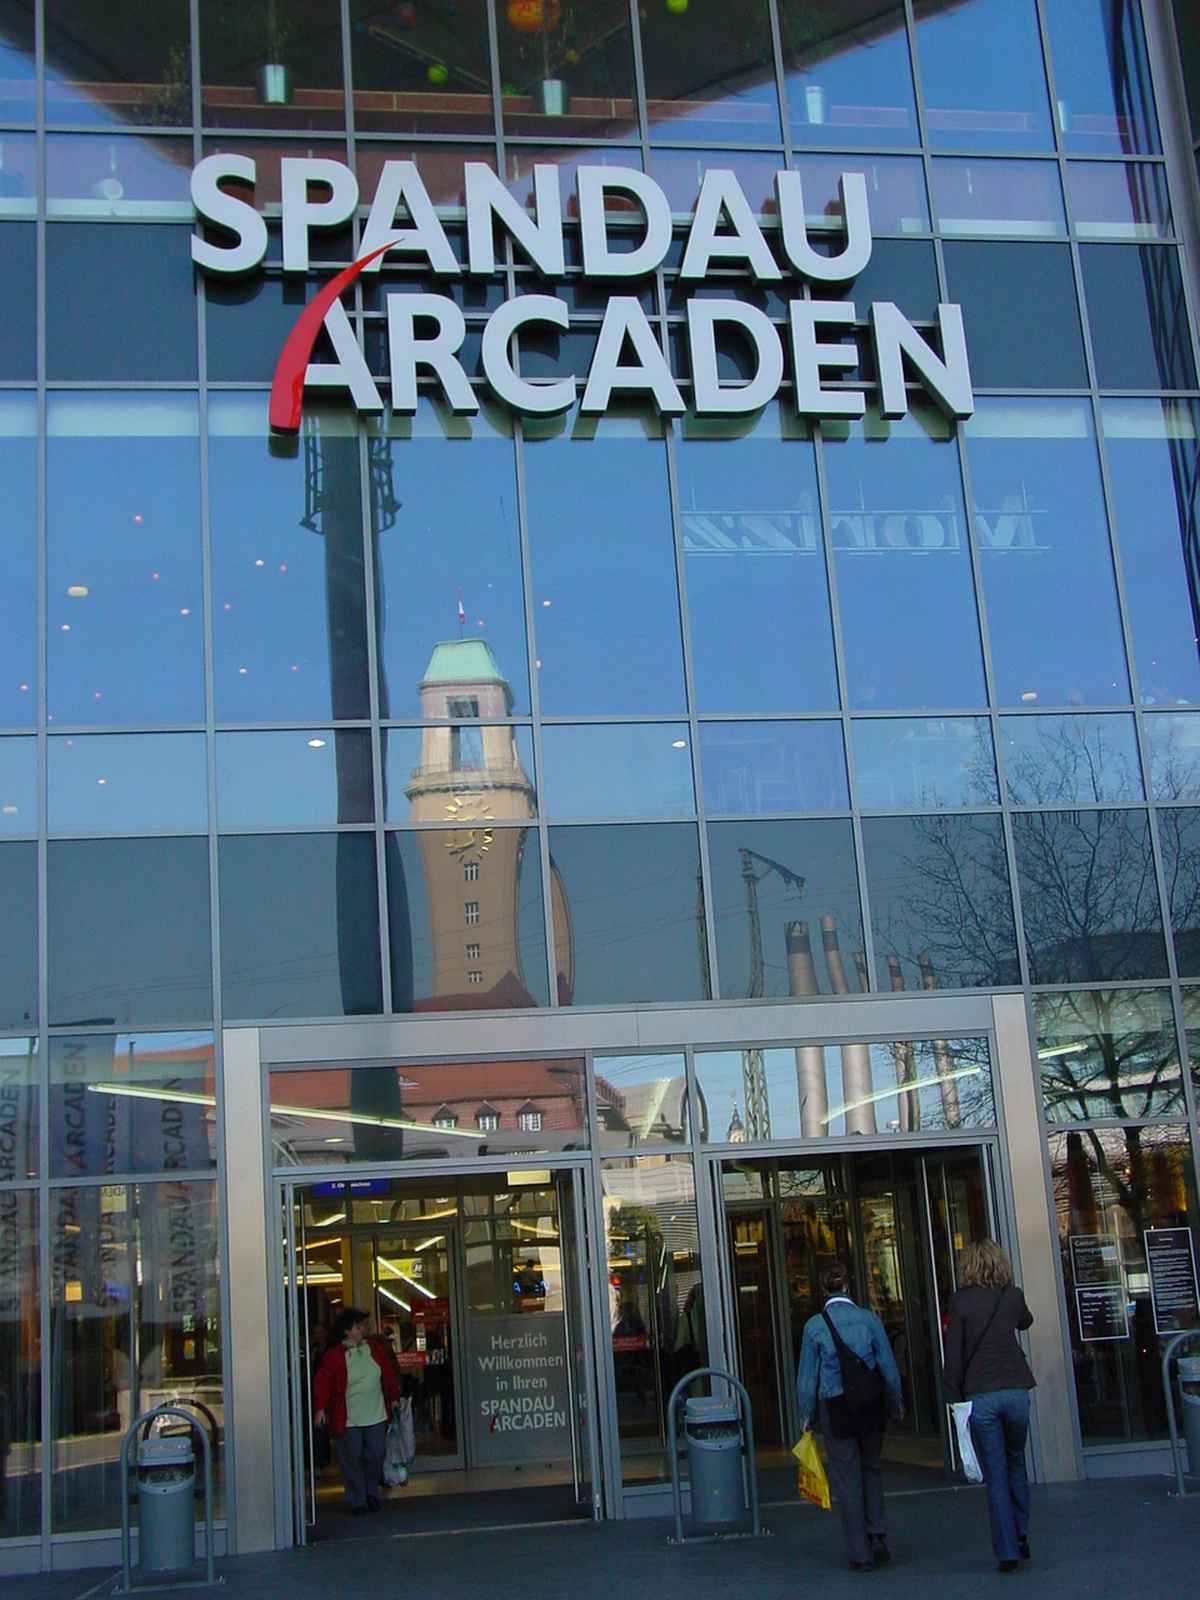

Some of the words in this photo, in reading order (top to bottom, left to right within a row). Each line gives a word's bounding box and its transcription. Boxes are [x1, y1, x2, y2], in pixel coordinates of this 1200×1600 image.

[190, 154, 873, 284] SPANDAU
[269, 285, 975, 434] ARCADEN
[62, 1043, 87, 1170] ARCADEN
[491, 1332, 548, 1350] Herzlich
[478, 1355, 564, 1371] Willkommen
[495, 1376, 508, 1391] in
[512, 1376, 548, 1390] Ihren
[480, 1395, 555, 1416] SPANDAU
[489, 1411, 566, 1432] ARCADEN
